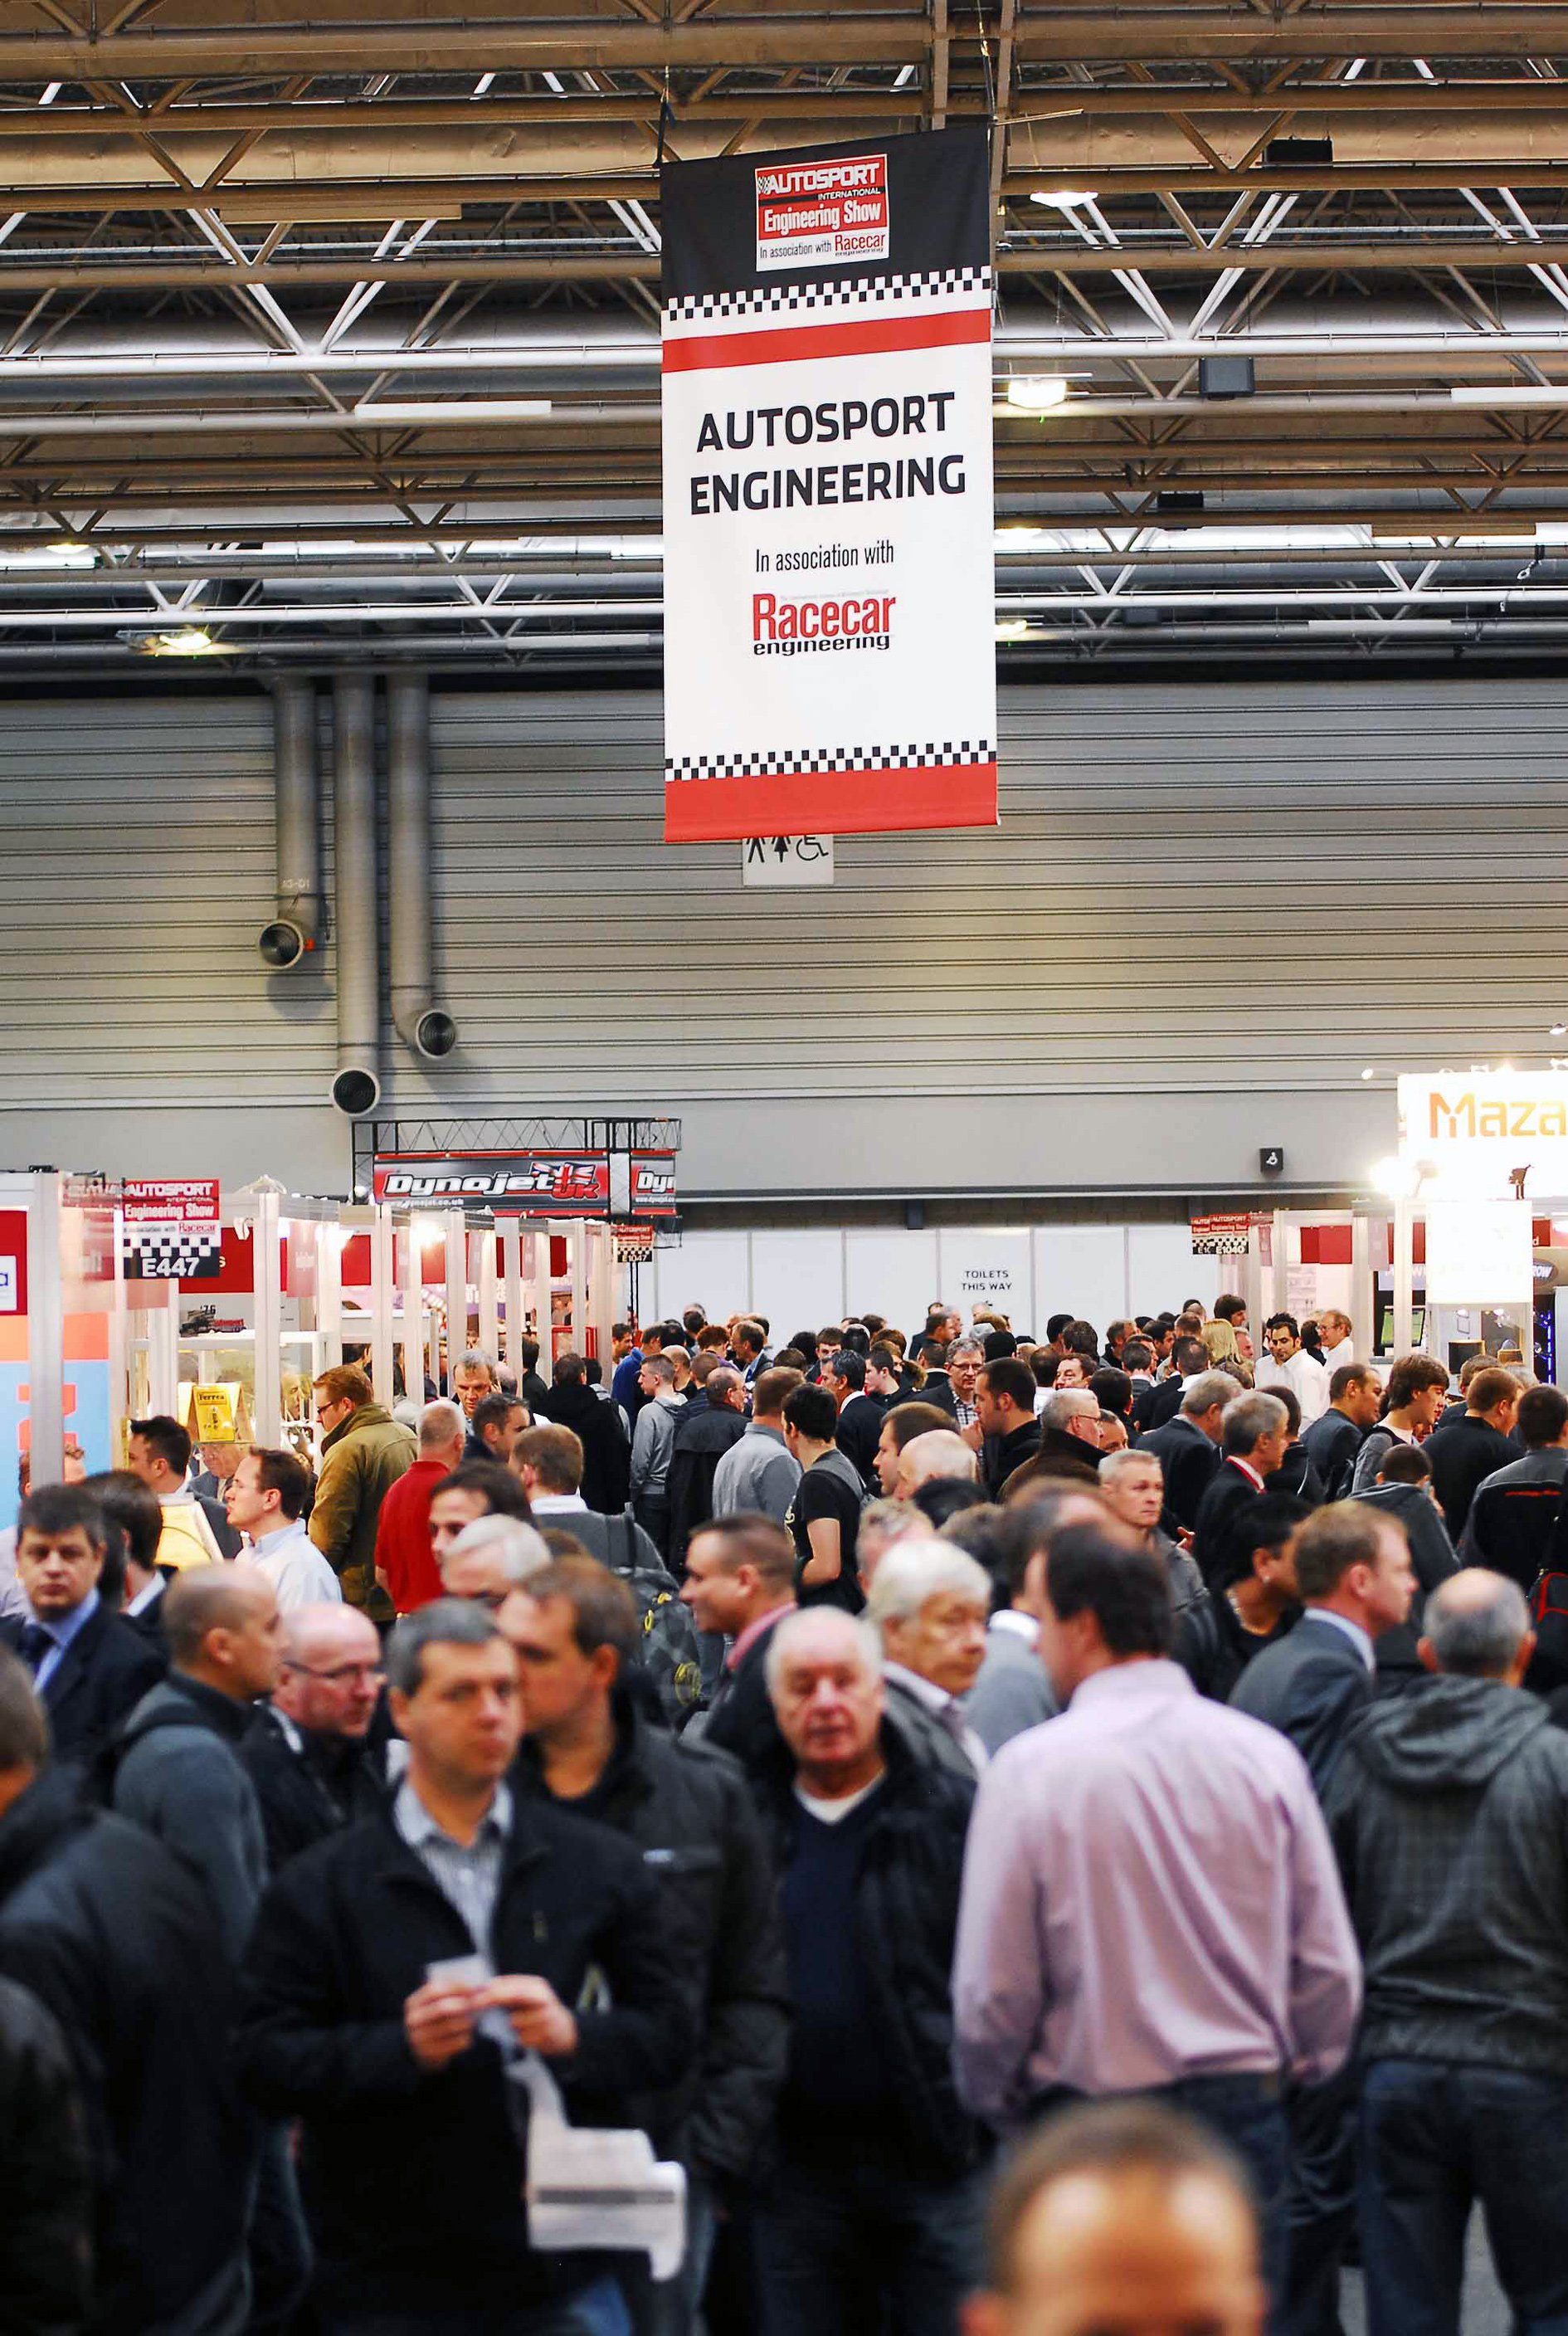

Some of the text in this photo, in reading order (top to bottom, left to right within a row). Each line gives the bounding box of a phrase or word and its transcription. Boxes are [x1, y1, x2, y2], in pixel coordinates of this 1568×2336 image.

[767, 163, 879, 194] AUTOSPORT
[818, 188, 881, 200] INTERNATIONAL
[764, 200, 881, 236] Engineering Show
[760, 234, 885, 259] In association with Racecar
[697, 392, 955, 452] AUTOSPORT
[690, 455, 965, 515] ENGINEERING
[756, 539, 894, 572] In association with
[752, 593, 896, 641] Racecar
[753, 636, 889, 656] engineering
[1429, 1092, 1566, 1138] Maza
[127, 1183, 213, 1197] AUTOSPORT
[385, 1172, 599, 1199] Dynojet UK
[124, 1203, 214, 1220] Engineering Show
[178, 1222, 216, 1233] Racecar
[622, 1254, 647, 1262] E1047
[1216, 1245, 1245, 1254] E1040
[142, 1256, 200, 1277] E447
[964, 1270, 1009, 1279] TOILETS
[962, 1282, 1012, 1290] THIS WAY
